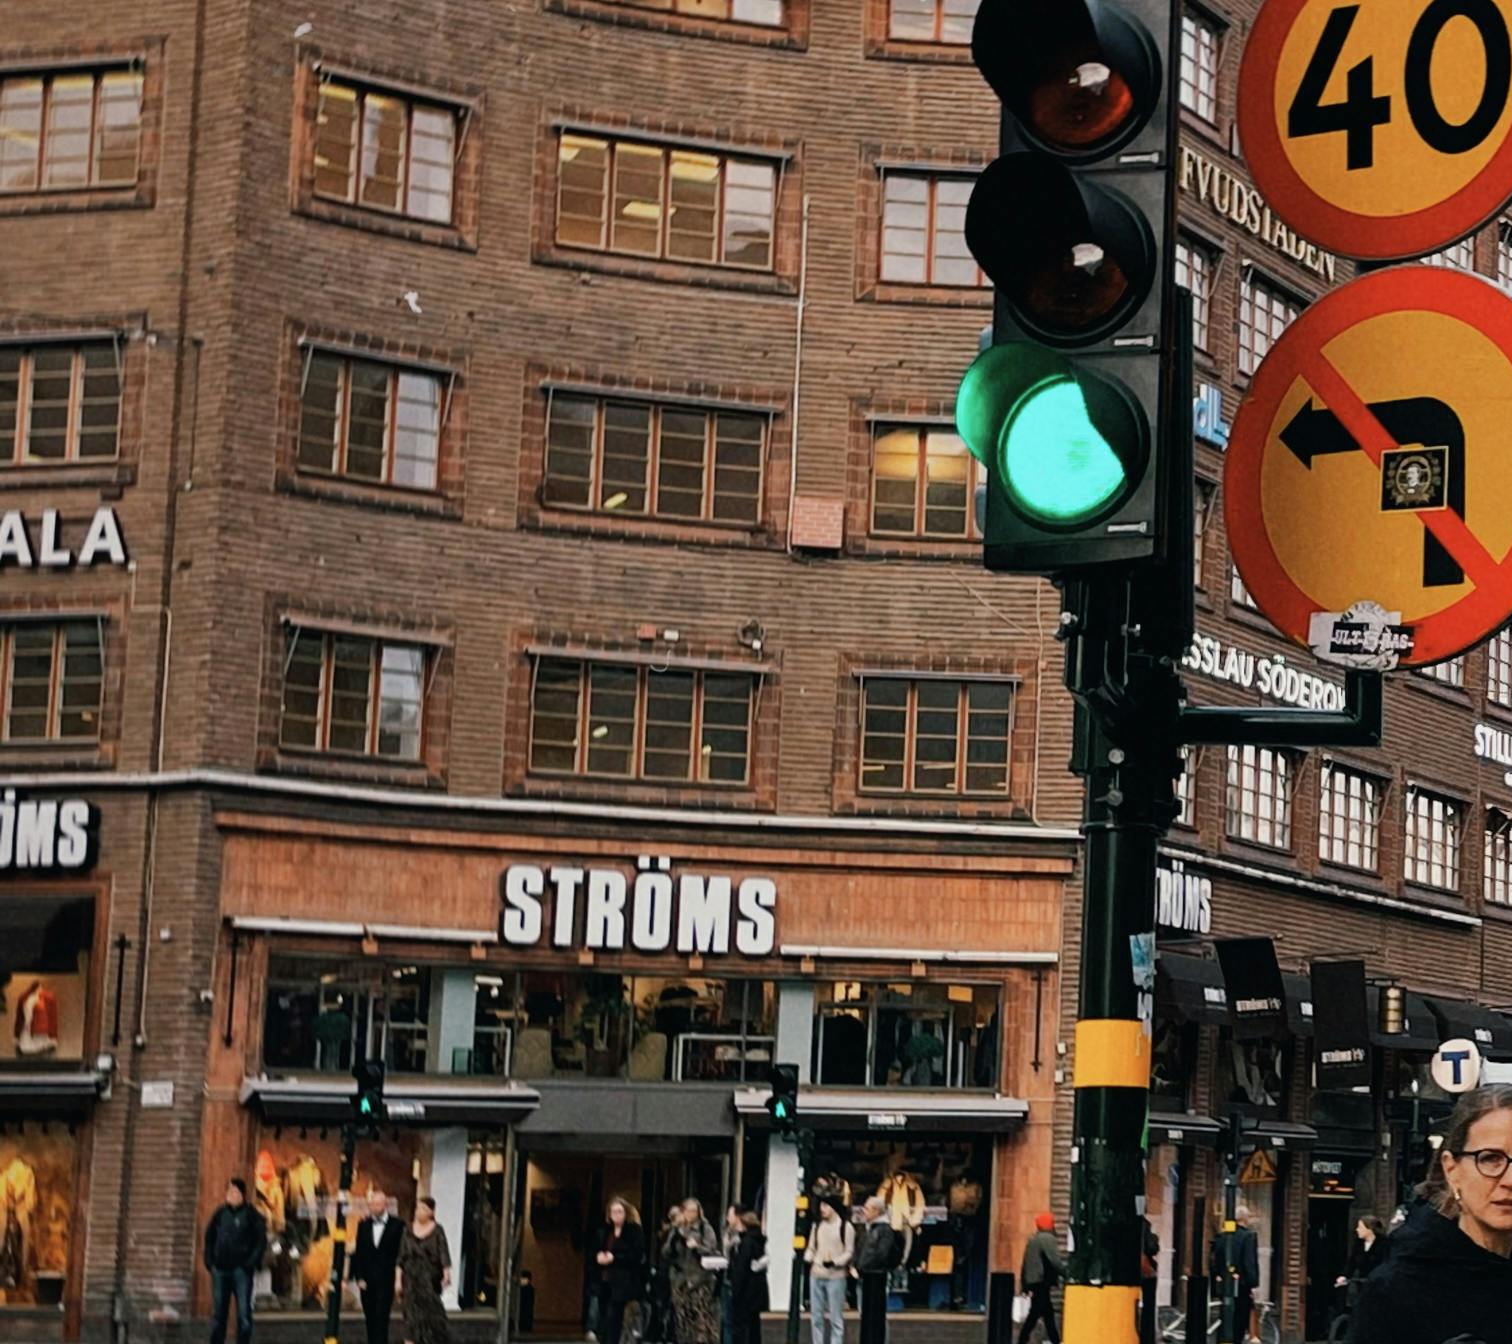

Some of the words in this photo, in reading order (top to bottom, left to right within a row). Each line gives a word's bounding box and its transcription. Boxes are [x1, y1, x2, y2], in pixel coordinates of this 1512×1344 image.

[1178, 146, 1336, 282] FVUDSTADEN
[1182, 632, 1254, 687] SSLAU
[503, 854, 777, 955] STRÖMS
[1154, 859, 1212, 934] RÖMS
[1441, 1050, 1470, 1085] T
